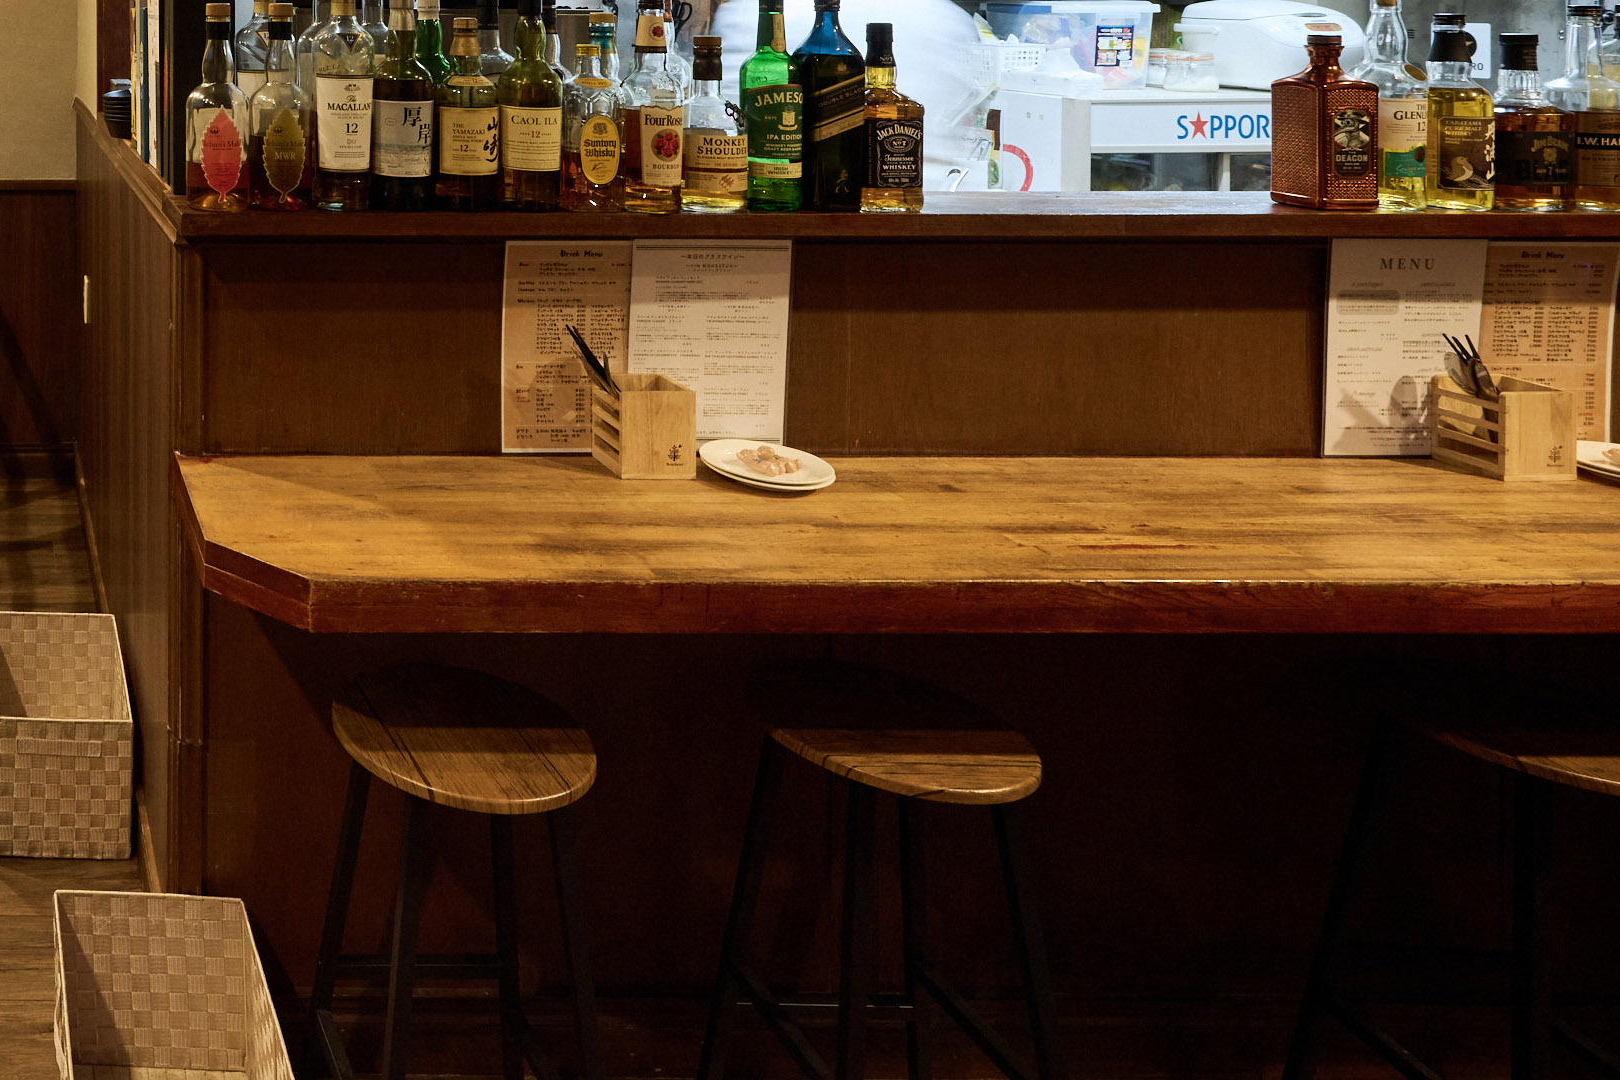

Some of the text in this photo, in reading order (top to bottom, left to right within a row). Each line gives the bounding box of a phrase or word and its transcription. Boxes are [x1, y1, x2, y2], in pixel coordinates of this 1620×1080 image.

[327, 102, 371, 112] MACALLAN
[511, 115, 558, 126] CAOL ILA
[345, 123, 359, 134] 12
[876, 126, 895, 141] JACK
[531, 130, 541, 139] 12
[584, 139, 617, 150] Suntory
[703, 137, 745, 147] MONKEY
[1601, 137, 1620, 146] HA
[459, 144, 469, 152] 12
[584, 148, 615, 159] Whisky
[1335, 154, 1368, 162] DEACON
[1379, 257, 1436, 270] MENU
